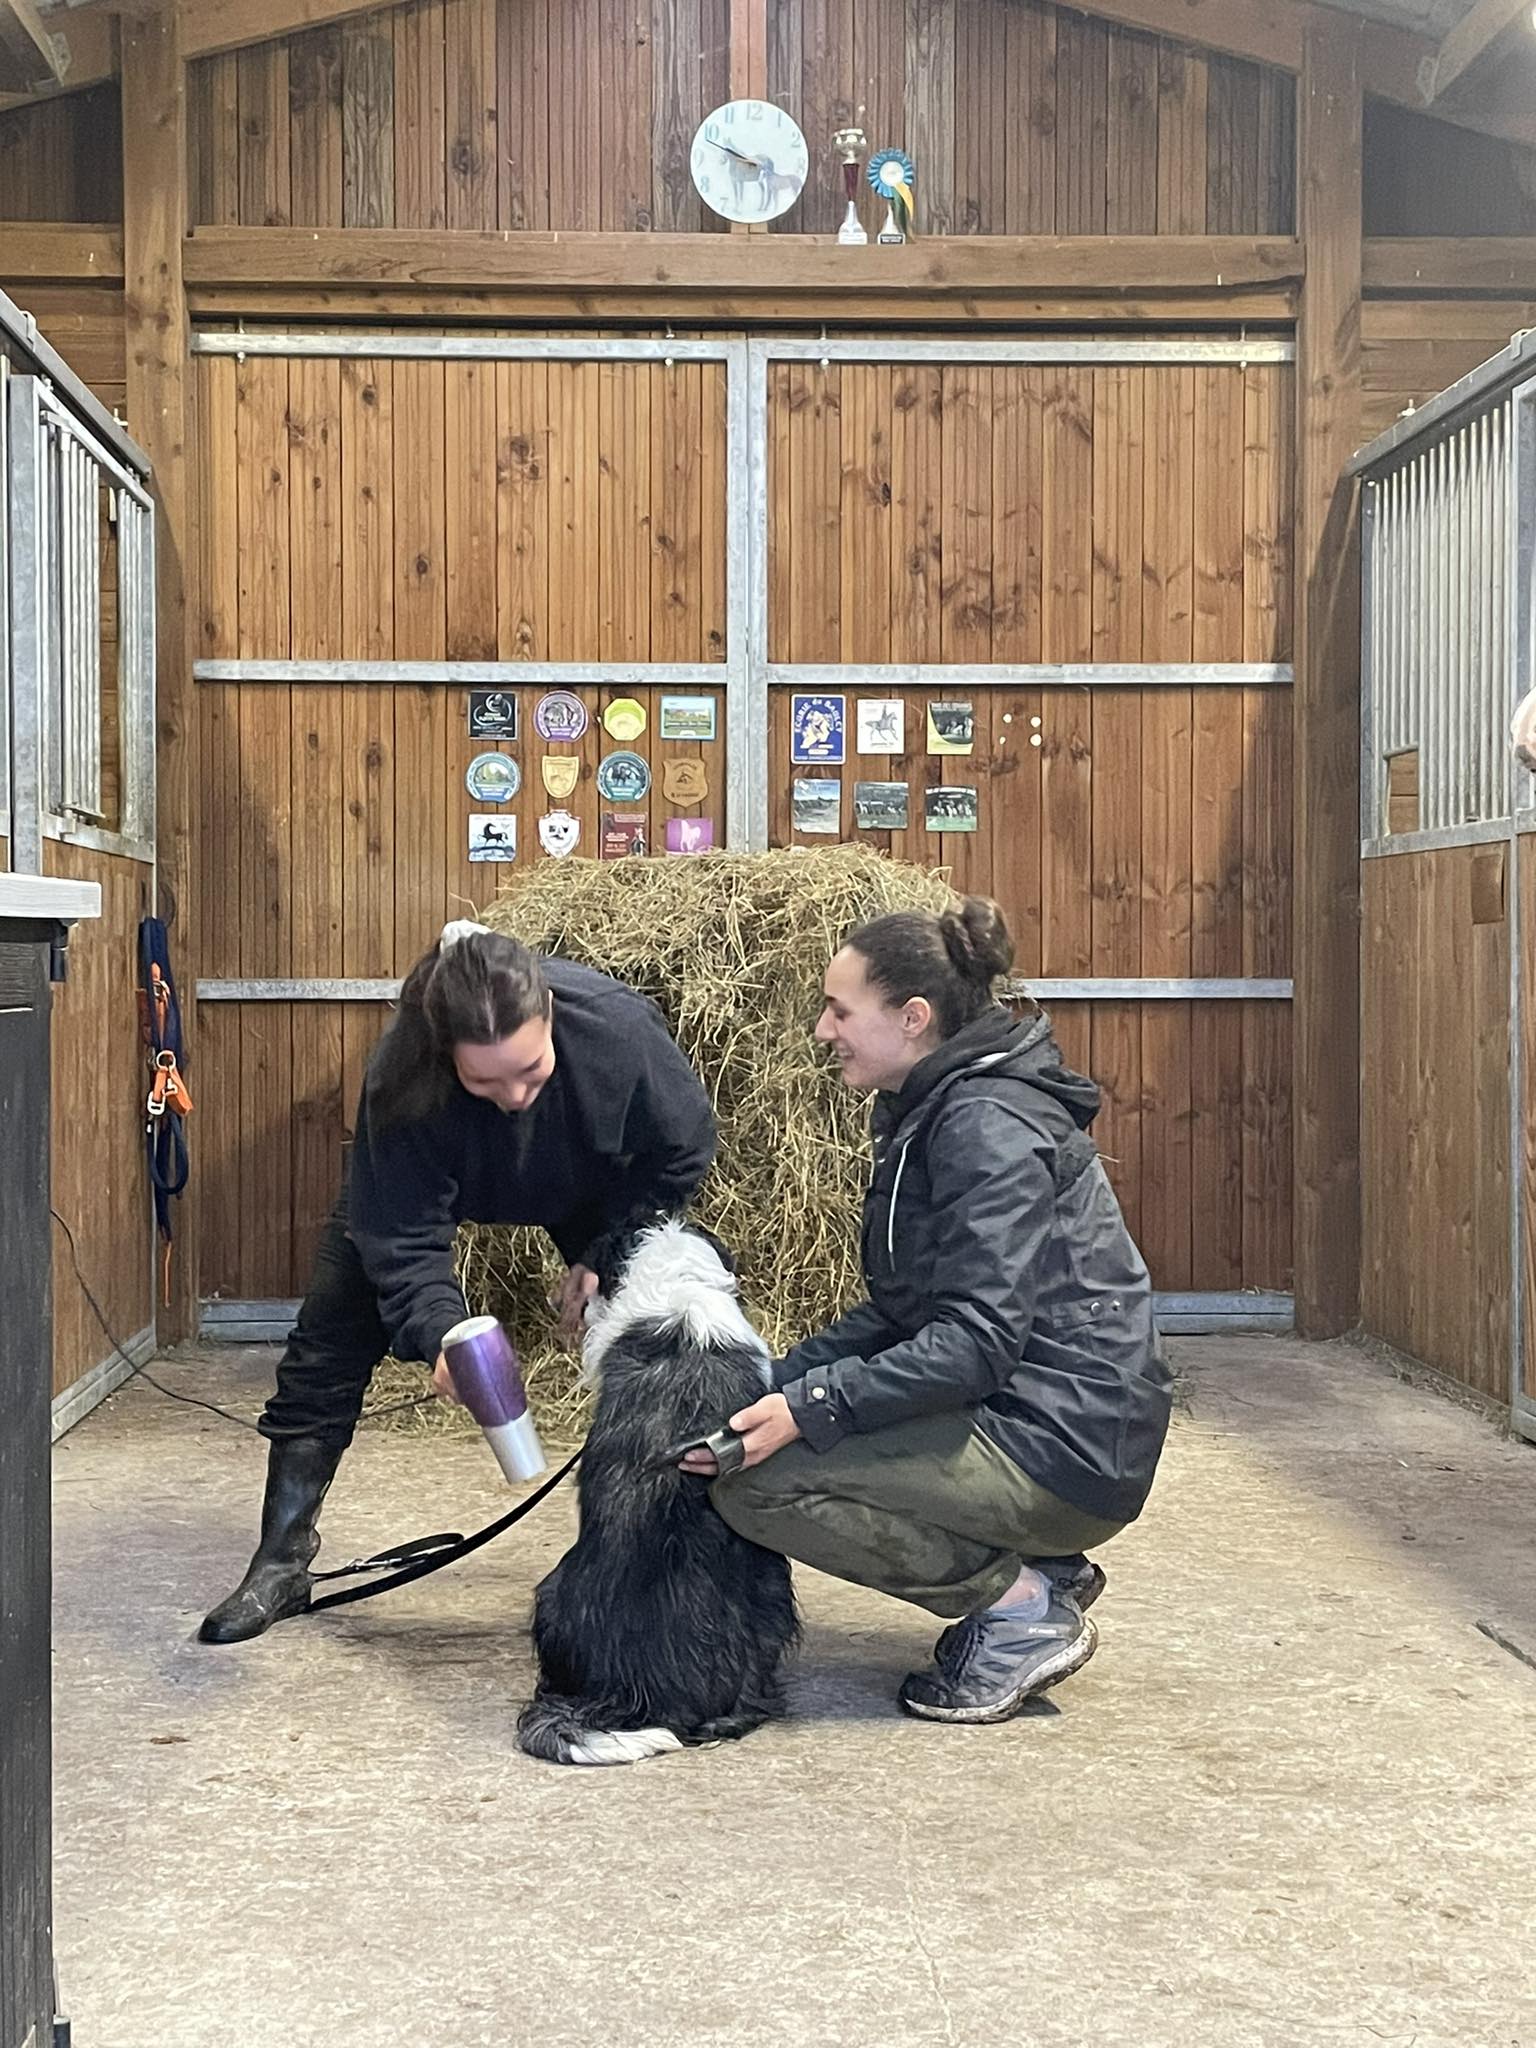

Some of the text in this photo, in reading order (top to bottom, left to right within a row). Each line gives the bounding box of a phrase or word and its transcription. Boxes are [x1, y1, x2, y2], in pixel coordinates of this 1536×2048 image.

[724, 106, 735, 124] 11
[746, 103, 762, 120] 12
[777, 111, 782, 128] 1
[704, 123, 720, 141] 10
[791, 131, 801, 148] 2
[700, 175, 710, 193] 8
[719, 196, 729, 212] 7
